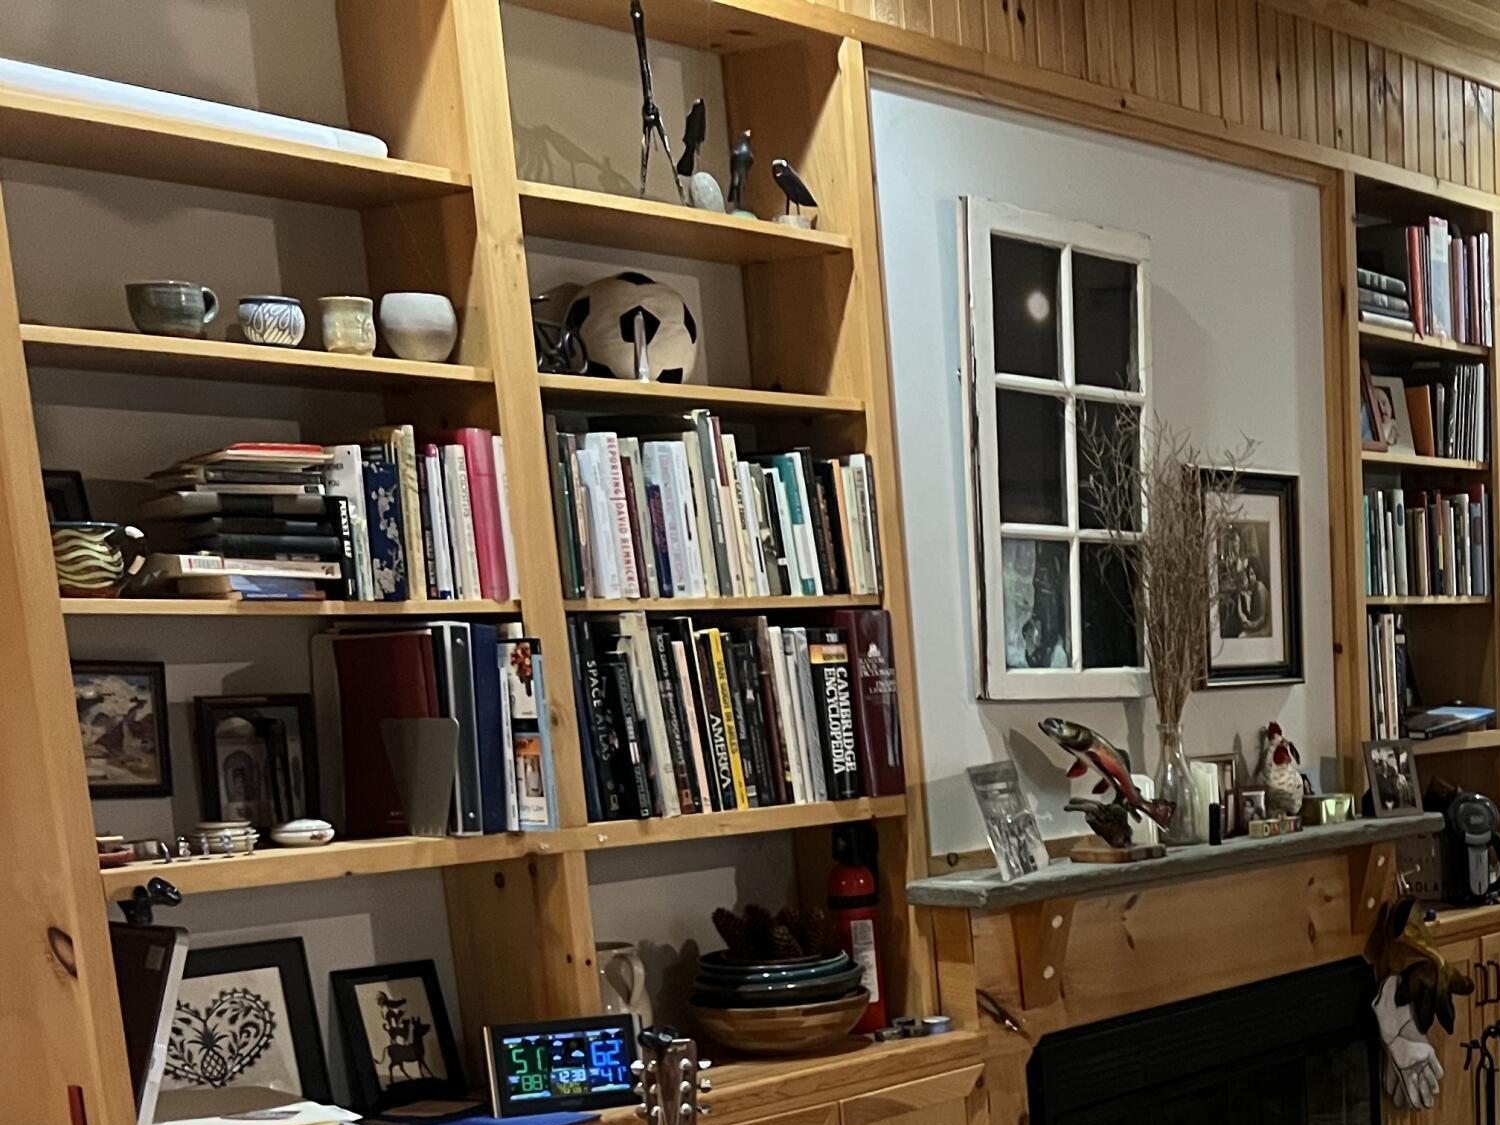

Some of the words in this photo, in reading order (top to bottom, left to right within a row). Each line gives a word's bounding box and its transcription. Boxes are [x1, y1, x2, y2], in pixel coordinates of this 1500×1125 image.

[606, 437, 625, 495] REPORTING
[338, 500, 350, 536] POCKET
[615, 502, 628, 534] DAVID
[620, 539, 636, 583] REMNICK
[586, 660, 602, 708] SPACE
[595, 712, 610, 761] ATLAS
[823, 667, 846, 775] ENCYCLOPEDIA
[836, 666, 857, 772] CAMBRIDGE
[709, 714, 732, 789] AMERICA
[511, 1047, 544, 1073] 51
[591, 1040, 620, 1066] 62
[521, 1074, 543, 1092] 88
[601, 1069, 623, 1082] 41
